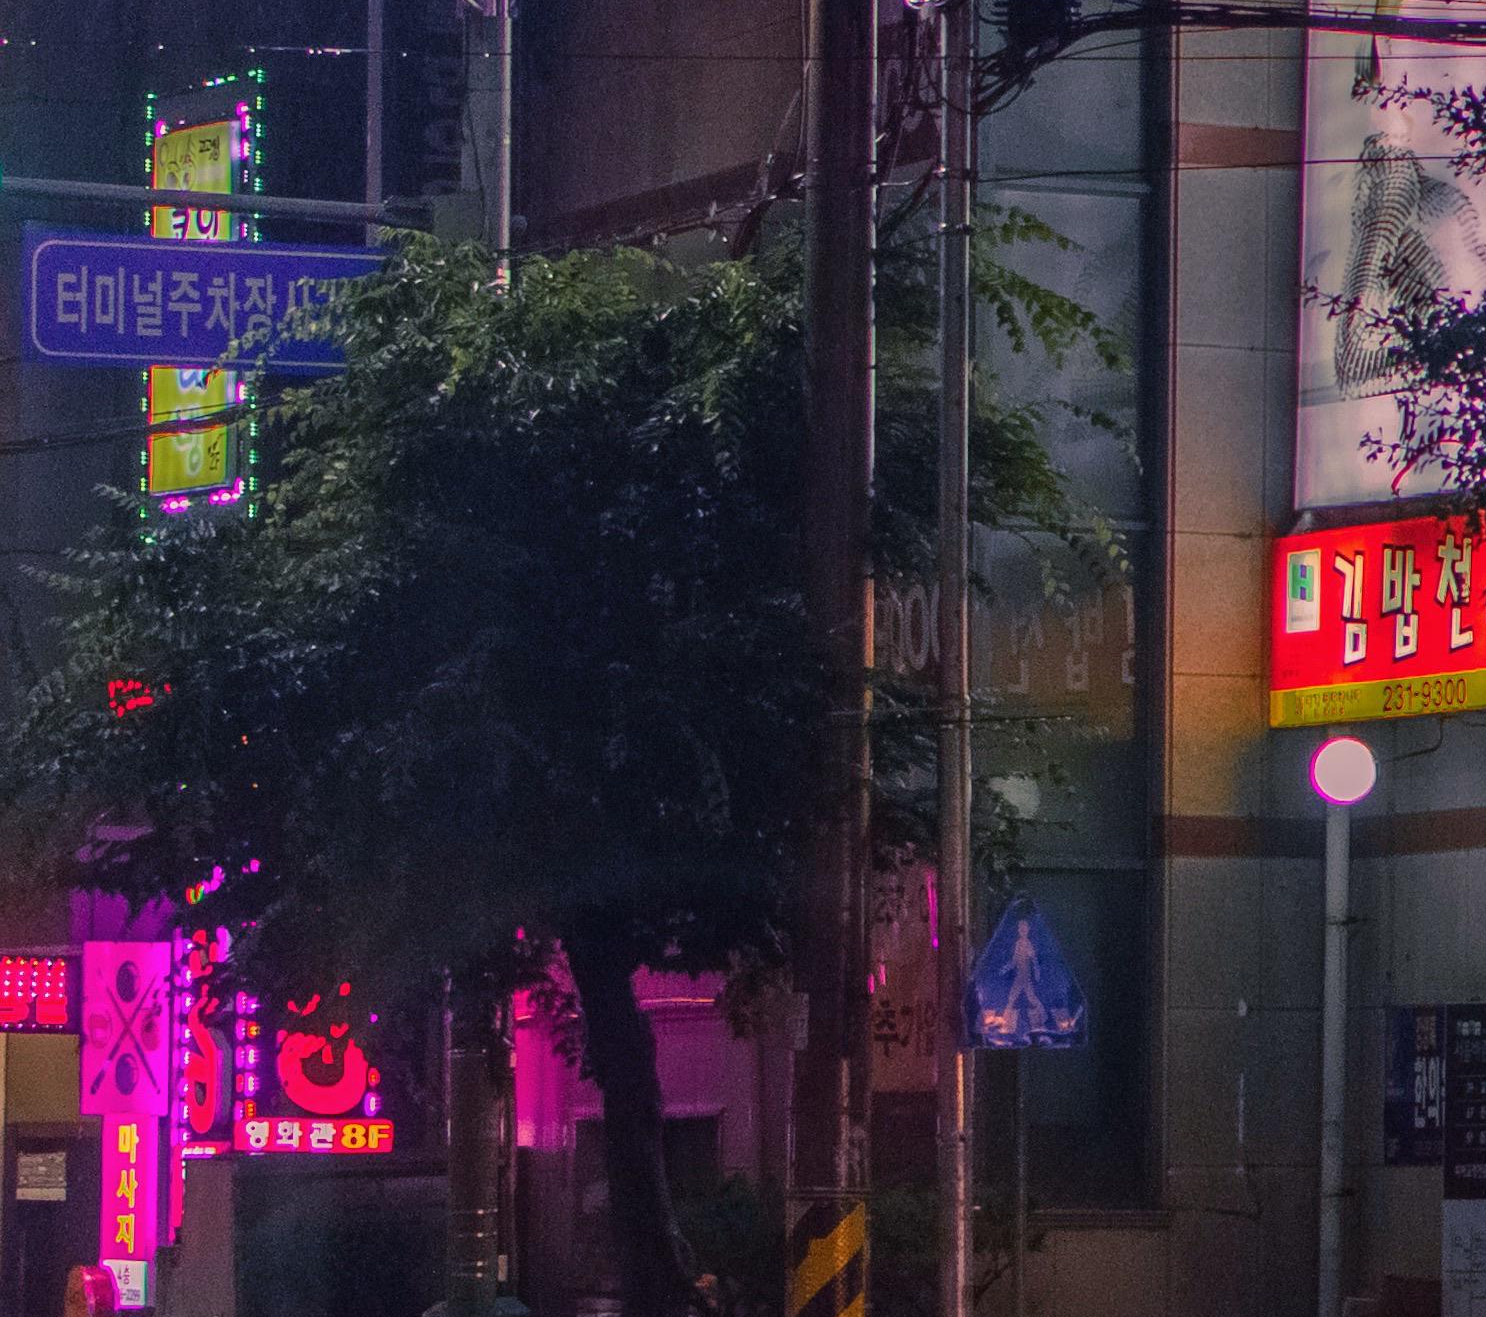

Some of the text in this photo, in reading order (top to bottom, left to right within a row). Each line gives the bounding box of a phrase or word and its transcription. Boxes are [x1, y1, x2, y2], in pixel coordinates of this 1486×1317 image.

[1382, 678, 1468, 713] 231-9300
[244, 1121, 392, 1150] 영화관 8F
[116, 1123, 140, 1254] 마사지
